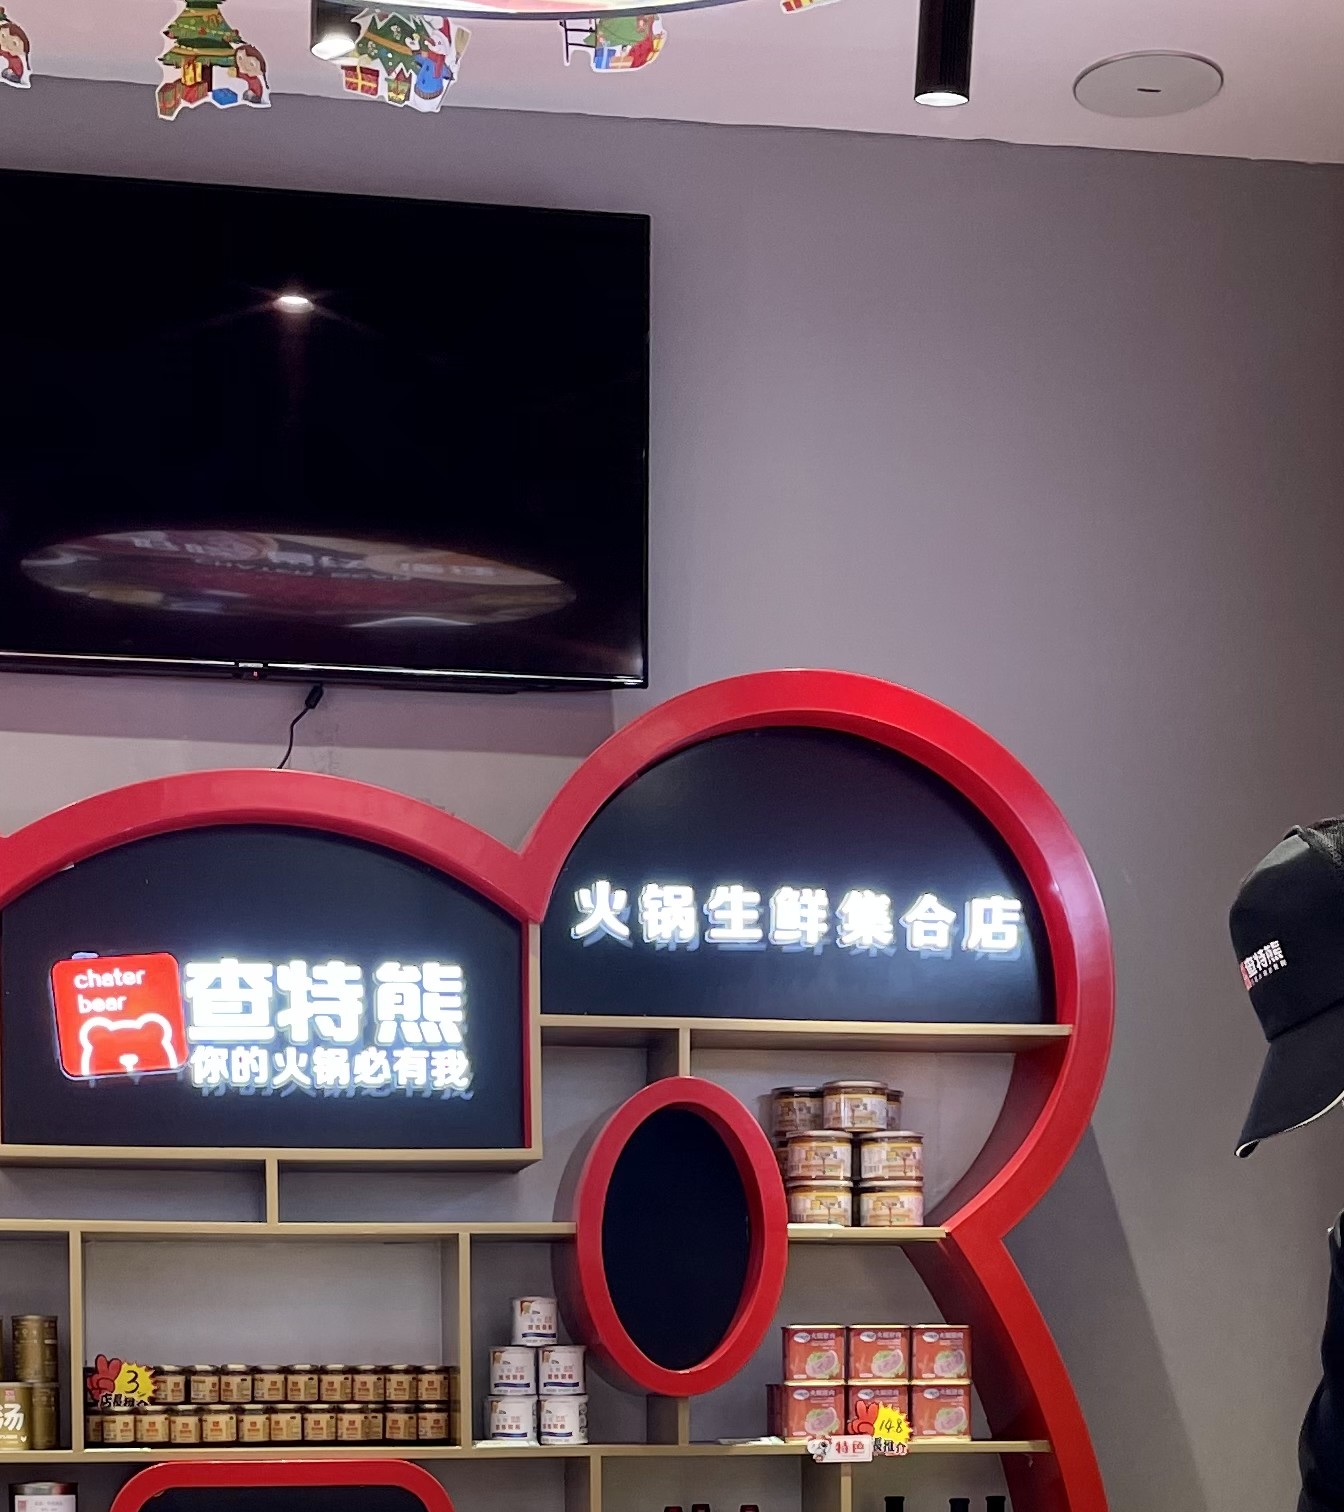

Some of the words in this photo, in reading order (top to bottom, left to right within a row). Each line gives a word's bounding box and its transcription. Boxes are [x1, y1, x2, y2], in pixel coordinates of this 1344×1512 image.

[572, 882, 1025, 951] 火锅生鲜集合店
[74, 966, 144, 990] chater
[77, 993, 127, 1014] bear
[186, 960, 467, 1045] 查特熊
[190, 1046, 471, 1090] 你的火锅必有我
